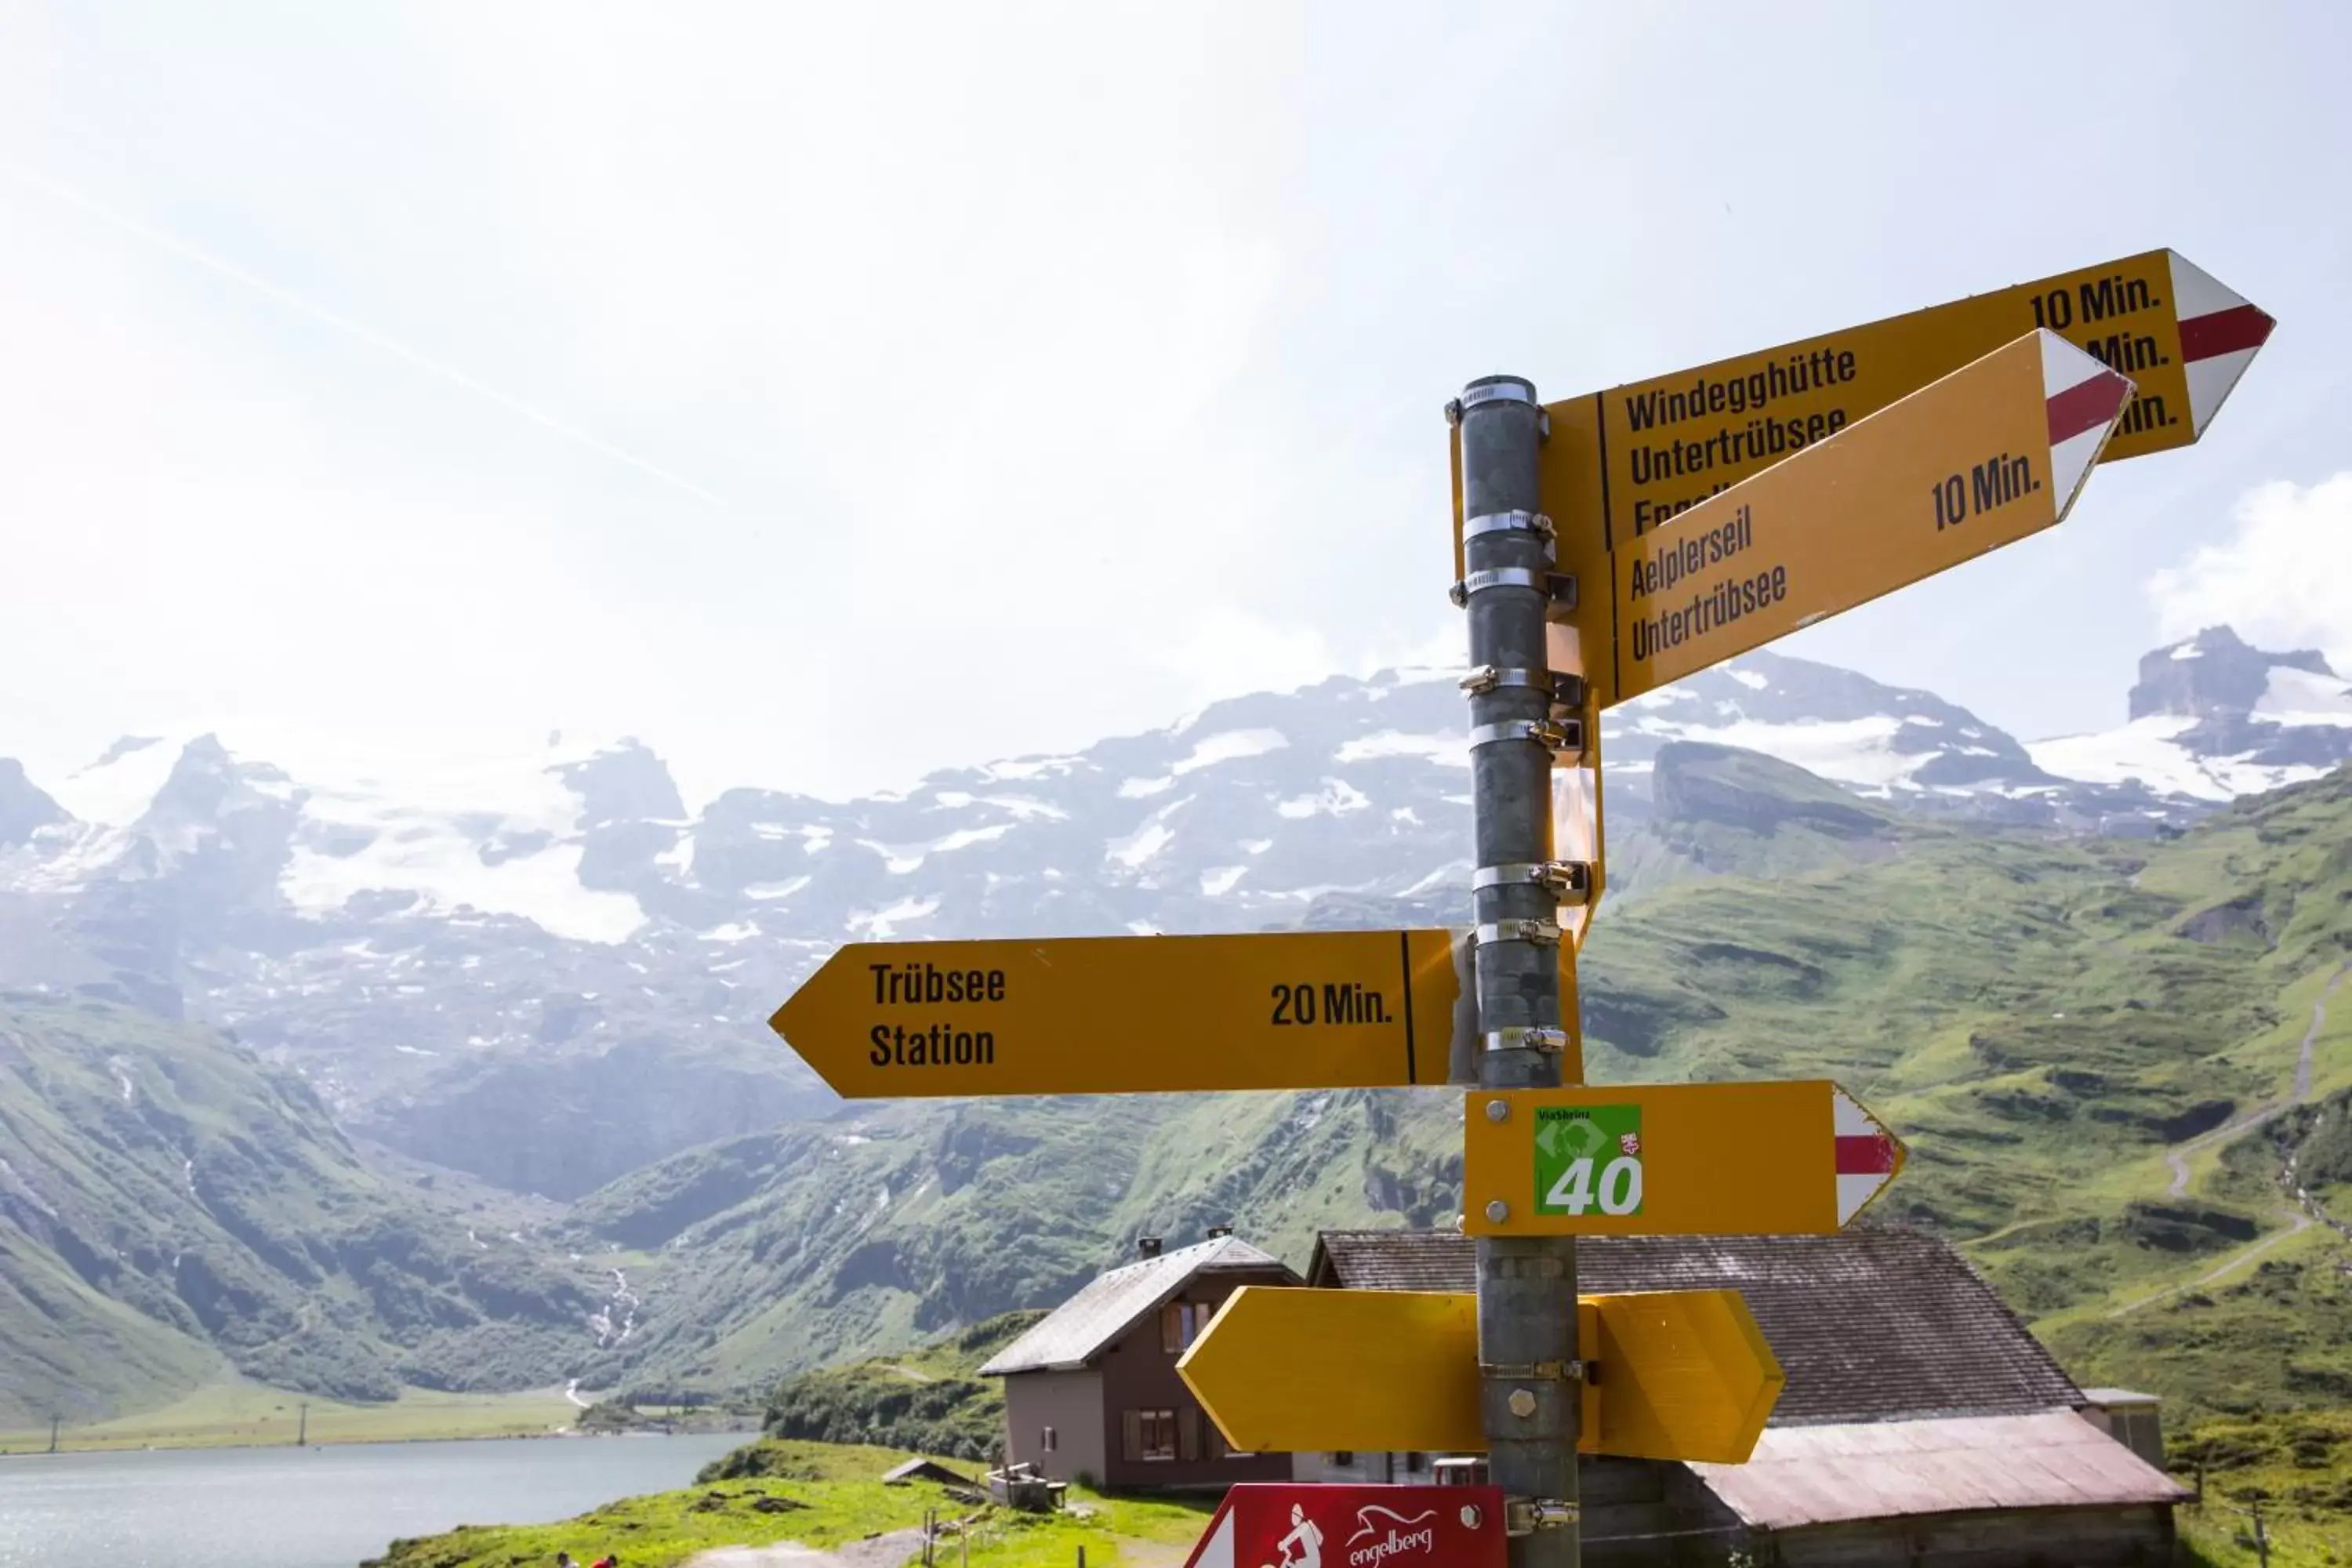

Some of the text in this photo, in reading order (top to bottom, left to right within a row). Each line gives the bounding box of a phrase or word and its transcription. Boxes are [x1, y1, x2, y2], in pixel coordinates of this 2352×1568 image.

[1625, 275, 2161, 433] Windegghütte 10 Min.
[2112, 392, 2178, 437] in.
[1631, 408, 1846, 485] Untertrübsee
[1631, 503, 1752, 601] Aelplerseil
[1632, 452, 2042, 662] Untertrübsee 10 Min.
[869, 963, 1006, 1004] Trübsee
[1271, 982, 1393, 1025] 20 Min.
[869, 1022, 994, 1067] Station
[1545, 1156, 1642, 1215] 40
[1349, 1528, 1432, 1568] engelberg
